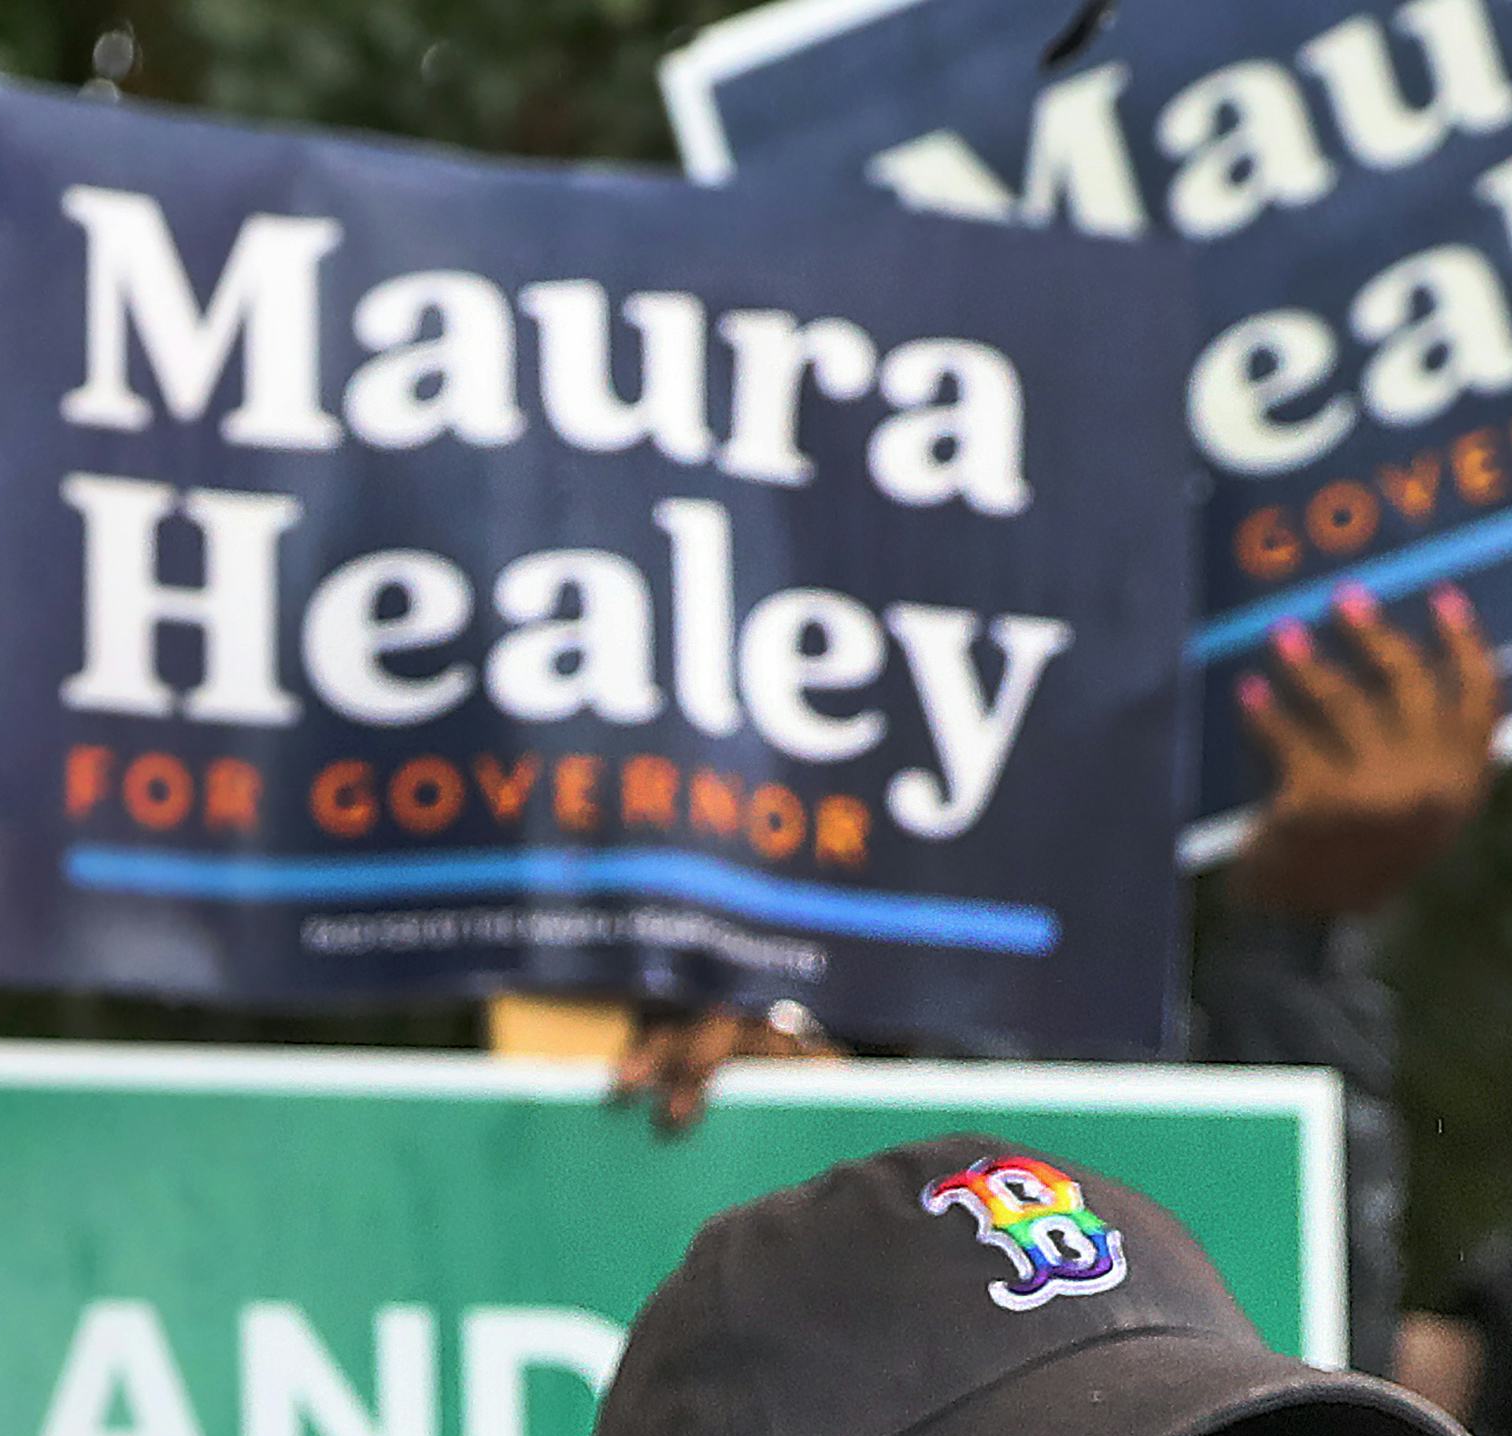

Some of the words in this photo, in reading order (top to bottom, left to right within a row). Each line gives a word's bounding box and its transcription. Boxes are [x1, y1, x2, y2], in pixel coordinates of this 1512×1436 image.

[61, 185, 1032, 514] Maura
[61, 475, 1067, 840] Healey
[65, 744, 261, 830] FOR
[310, 750, 872, 871] GOVERNOR
[922, 1157, 1127, 1311] B
